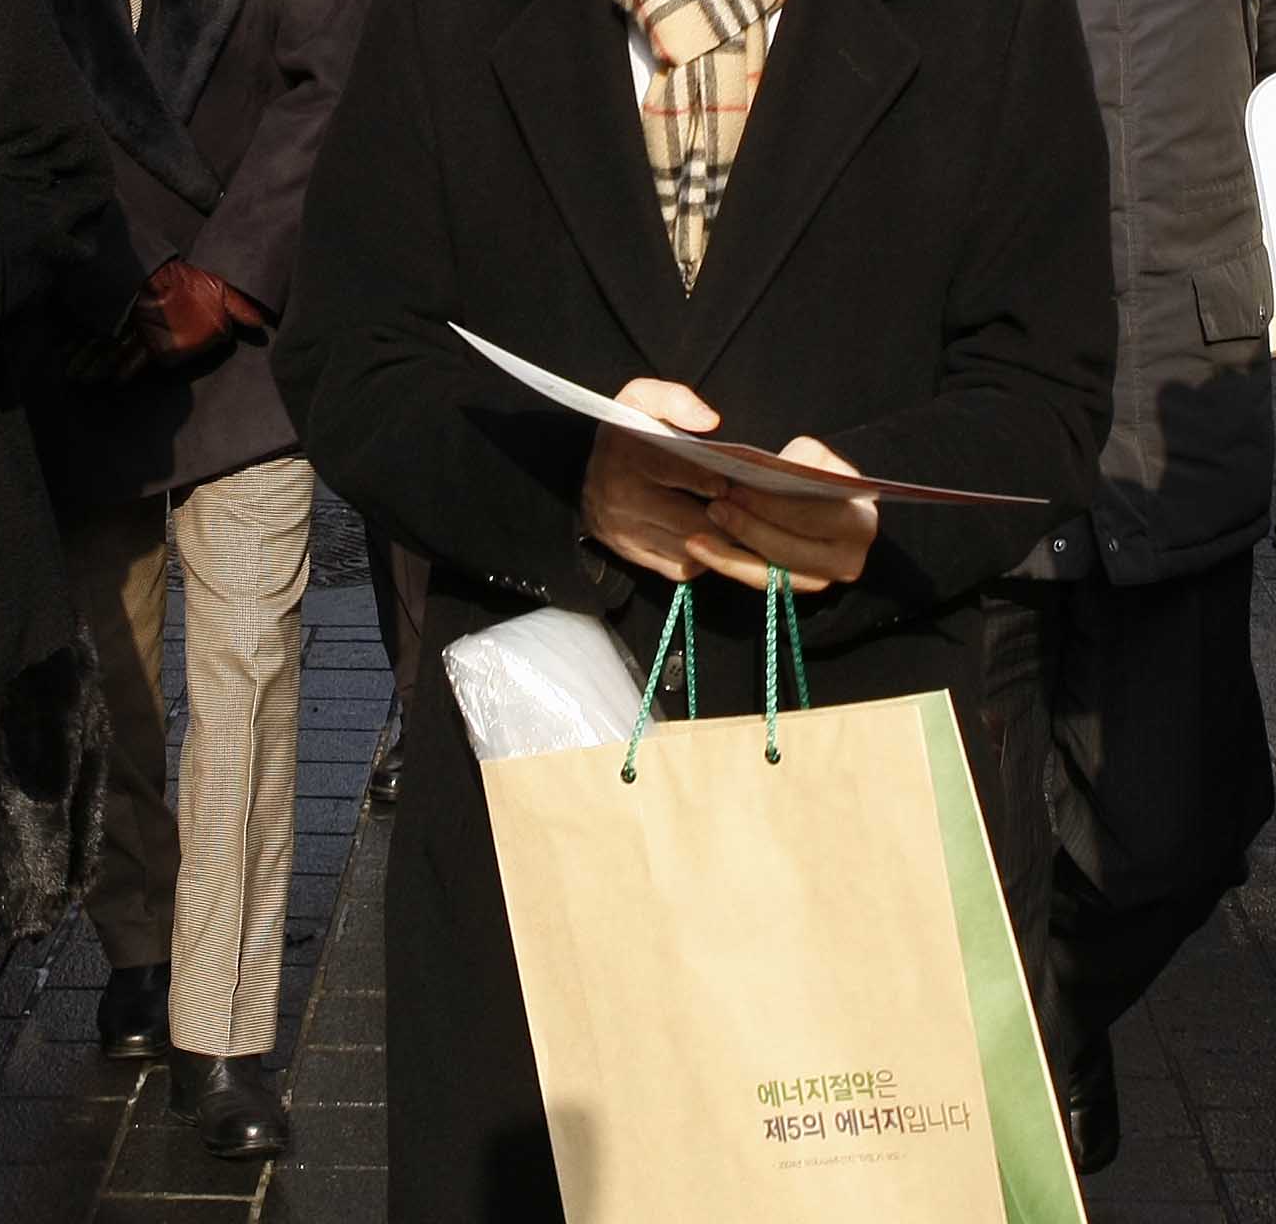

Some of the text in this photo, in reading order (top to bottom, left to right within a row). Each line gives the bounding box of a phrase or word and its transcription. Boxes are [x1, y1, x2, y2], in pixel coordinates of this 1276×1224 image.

[757, 1069, 898, 1108] 에너지절약은
[763, 1100, 972, 1144] 제5의 에너지입니다
